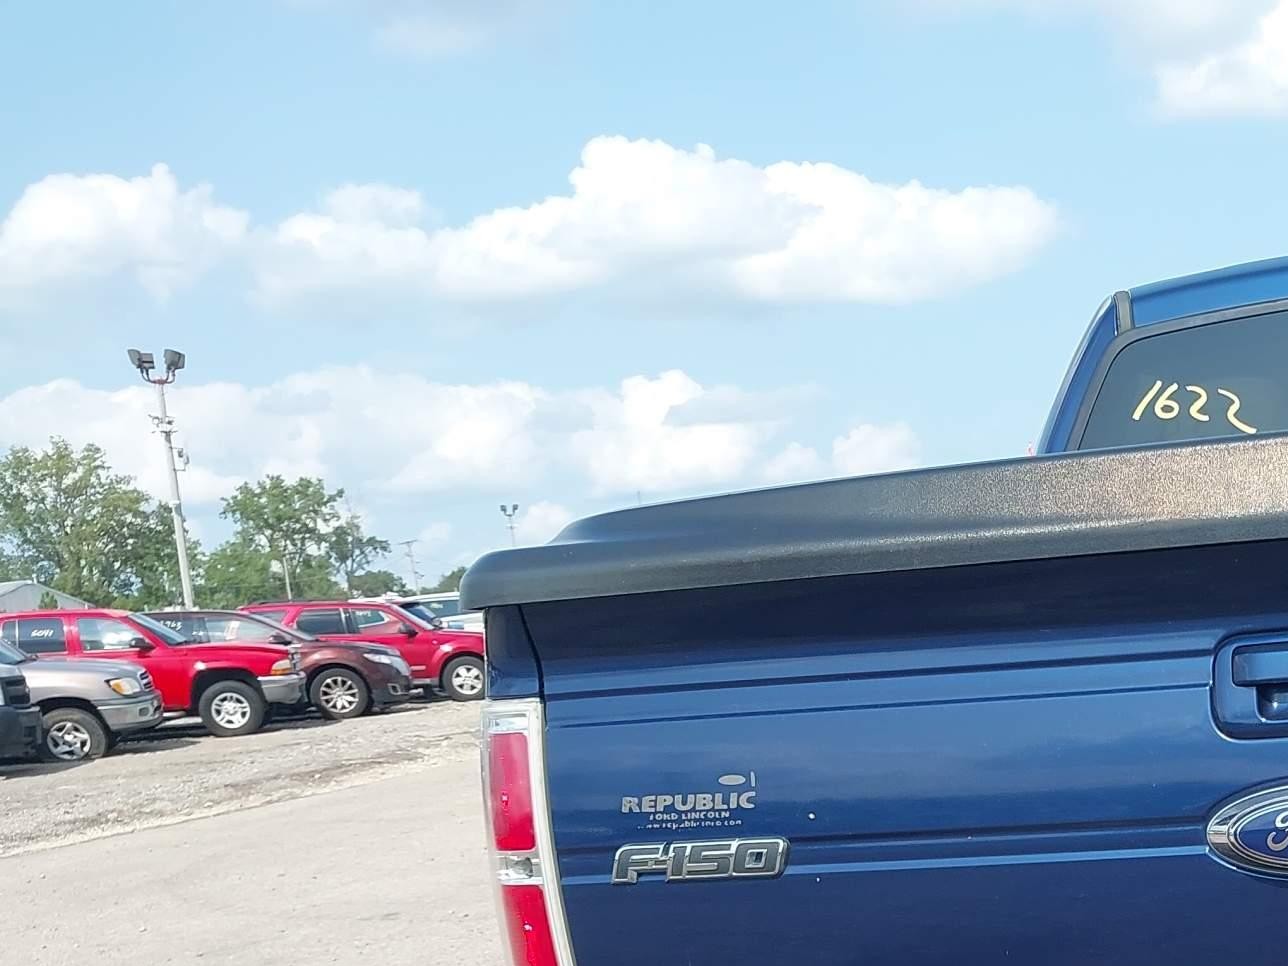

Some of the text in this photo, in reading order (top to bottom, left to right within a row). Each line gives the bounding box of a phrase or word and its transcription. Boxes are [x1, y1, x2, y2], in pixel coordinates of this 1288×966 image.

[1131, 379, 1257, 434] 1622
[621, 791, 757, 814] REPUBLIC
[681, 811, 730, 820] LINCOLN
[611, 836, 791, 885] F-150
